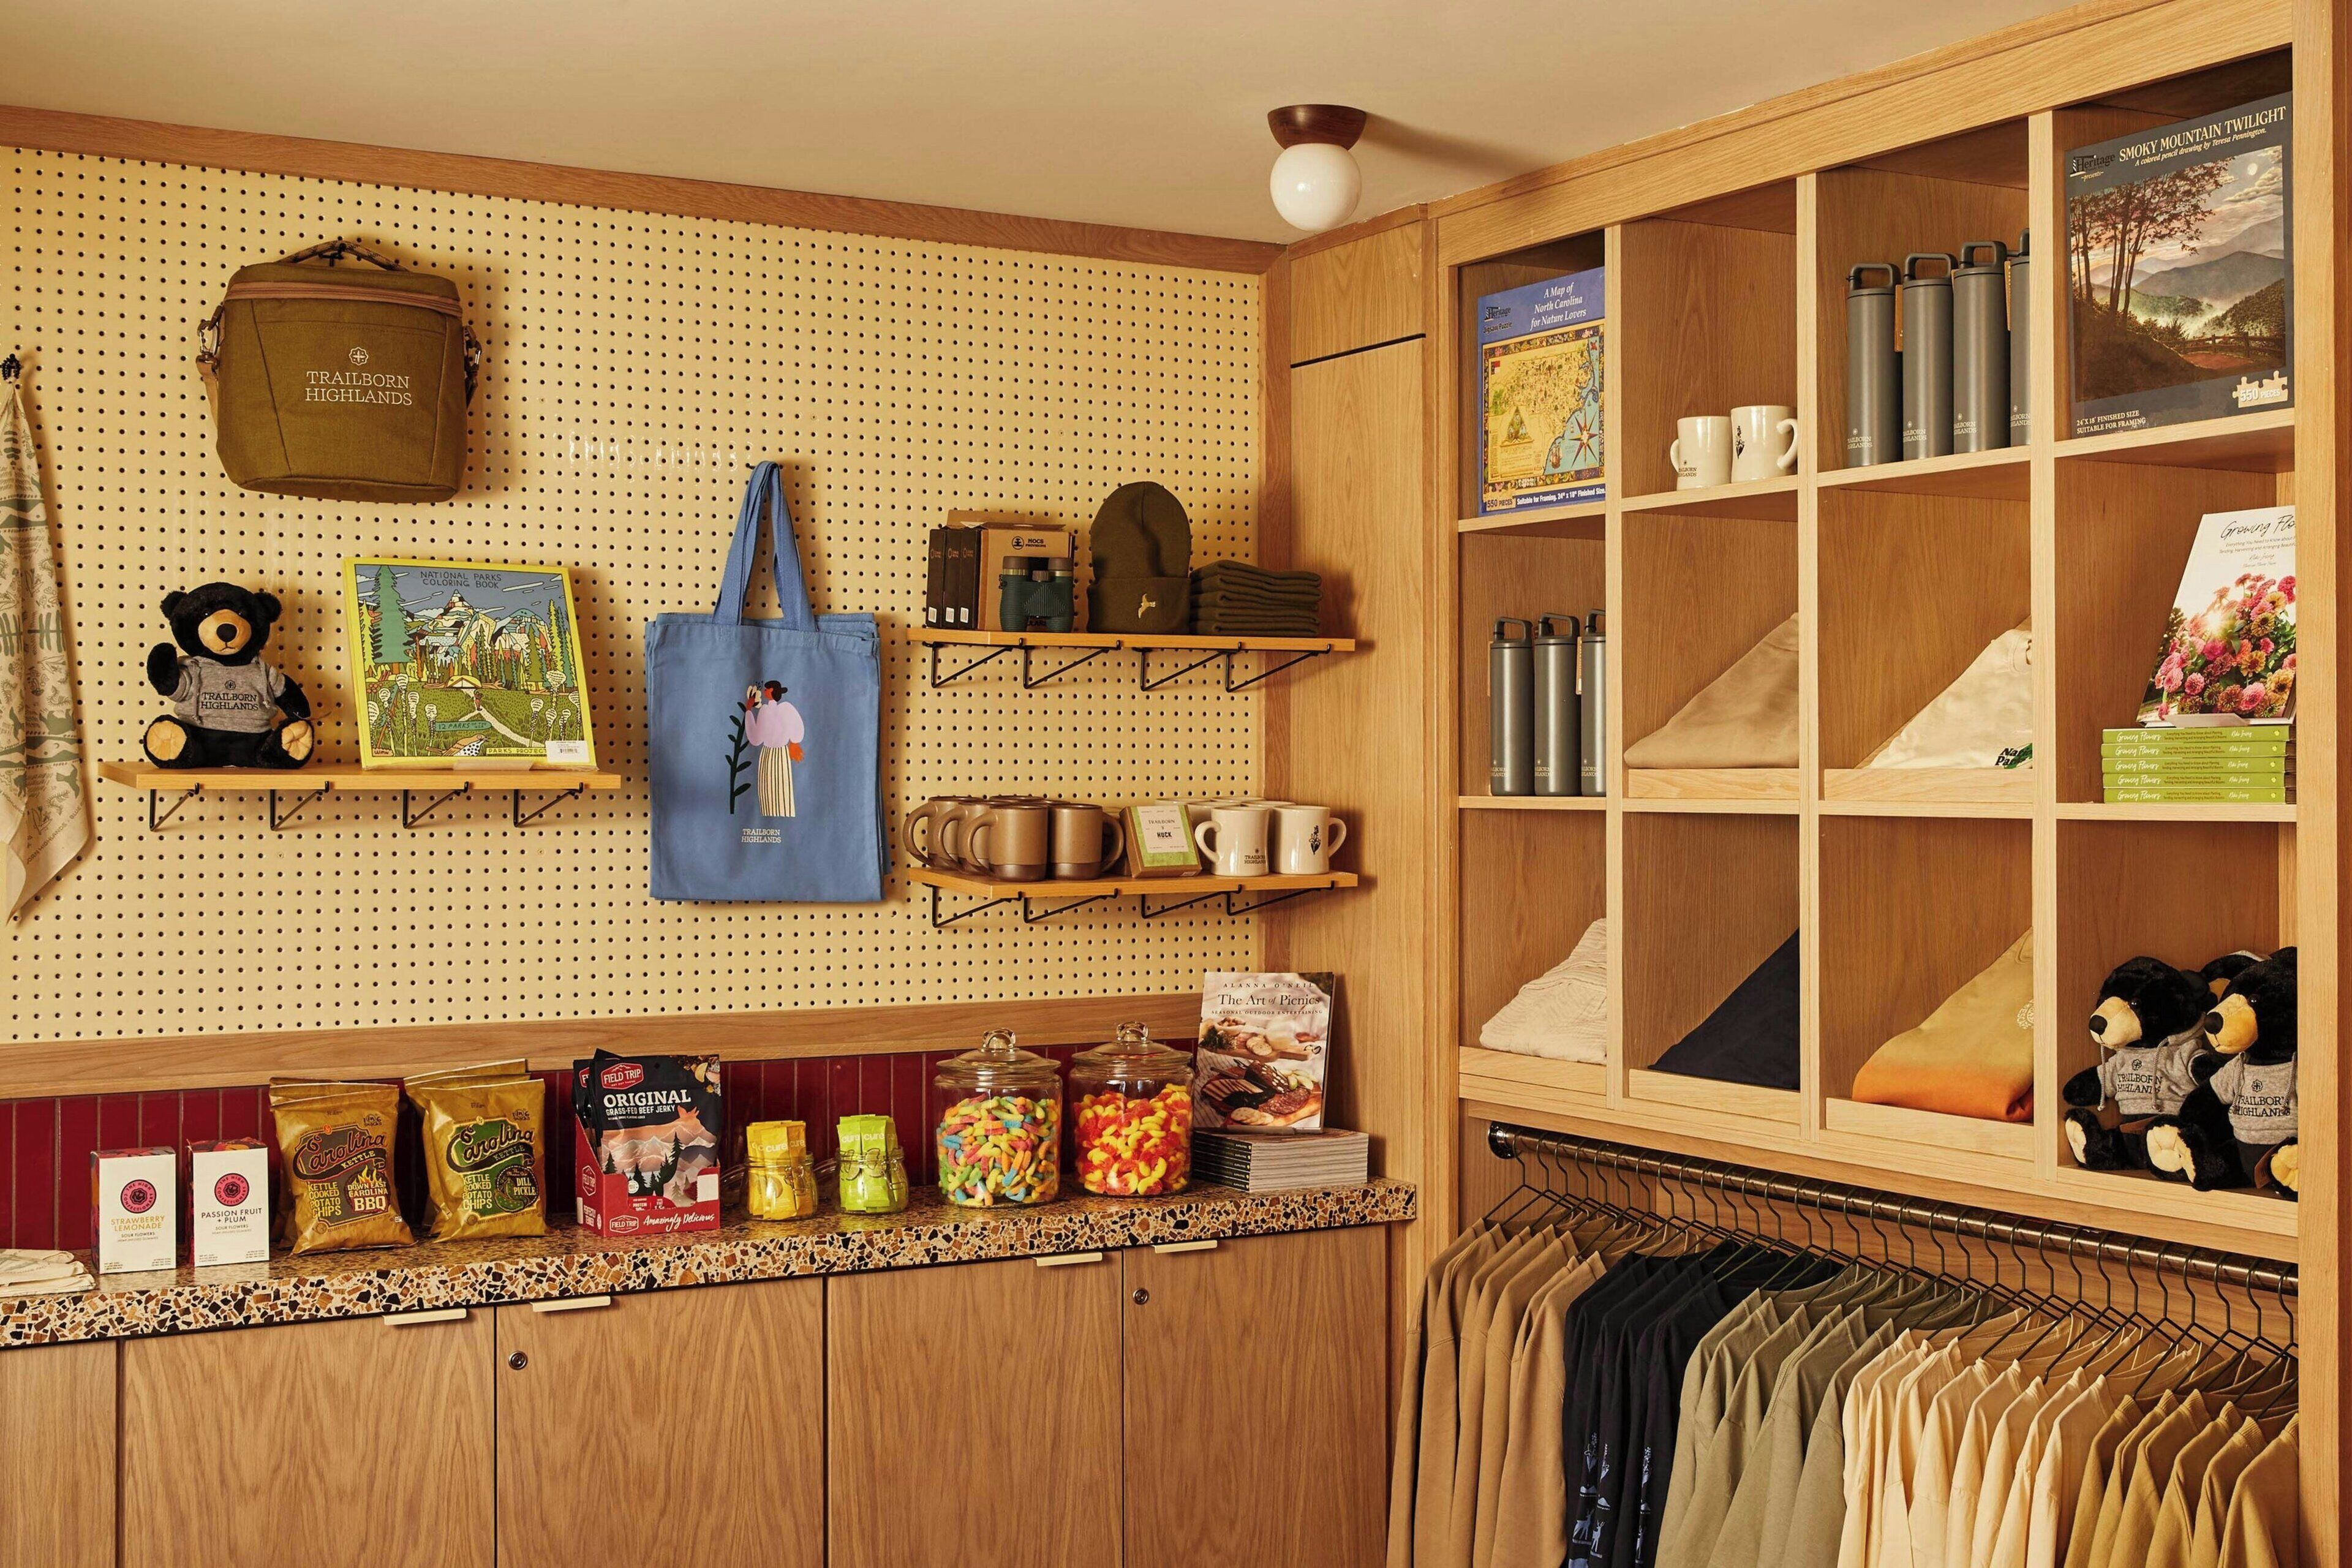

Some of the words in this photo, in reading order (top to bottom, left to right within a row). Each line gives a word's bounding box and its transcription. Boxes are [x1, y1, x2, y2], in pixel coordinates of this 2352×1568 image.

[2119, 140, 2158, 162] SMOKY
[2160, 123, 2222, 151] MOUNTAIN
[2225, 106, 2286, 134] TWILIGHT
[2141, 153, 2161, 165] colored
[2161, 149, 2178, 161] pencil
[2179, 144, 2203, 154] drawing
[2203, 141, 2211, 150] by
[2212, 138, 2231, 146] Teresa
[2232, 128, 2267, 141] Pennington.
[2074, 154, 2115, 172] Heritage
[1544, 289, 1550, 298] A
[1550, 286, 1565, 298] Map
[1566, 282, 1574, 295] of
[1534, 302, 1553, 314] North
[1555, 296, 1583, 309] Carolina
[1487, 307, 1511, 318] Heritage
[1530, 318, 1540, 331] for
[1542, 313, 1563, 325] Nature
[1565, 309, 1586, 320] Lovers
[306, 371, 410, 389] TRAILBORN
[305, 388, 412, 405] HIGHLANDS
[2240, 389, 2258, 402] 550
[2260, 388, 2280, 398] PIECES
[2097, 413, 2125, 423] FINISHED
[2126, 410, 2139, 418] SIZE
[2076, 424, 2105, 434] SUITABLE
[2117, 417, 2146, 428] FRAMING
[1578, 489, 1595, 497] Finished
[1487, 499, 1498, 508] 550
[2221, 521, 2271, 540] Growing
[202, 692, 257, 702] TRAILBORN
[201, 701, 258, 710] HIGHLANDS
[2117, 732, 2138, 742] Growing
[2140, 731, 2162, 741] Flowers
[2116, 746, 2137, 756] Growing
[2138, 745, 2160, 755] Flowers
[2116, 761, 2137, 772] Growing
[2138, 761, 2159, 770] Flowers
[2118, 775, 2139, 785] Growing
[2141, 774, 2161, 784] Flowers
[2117, 791, 2139, 801] Growing
[2140, 790, 2161, 800] Flowers
[1218, 994, 1242, 1005] The
[1246, 995, 1266, 1005] Art
[1280, 994, 1321, 1006] Picnics
[603, 1072, 624, 1084] FIELD
[625, 1069, 641, 1079] TRIP
[603, 1089, 691, 1108] ORIGINAL
[606, 1107, 638, 1116] GRASS-FED
[639, 1106, 654, 1114] BEEF
[655, 1104, 676, 1113] JERKY
[864, 1132, 885, 1140] cure
[447, 1123, 534, 1167] Carolina
[766, 1142, 788, 1153] cure
[294, 1131, 386, 1175] Carolina
[492, 1145, 525, 1161] KETTLE
[341, 1150, 375, 1169] KETTLE
[463, 1174, 490, 1185] KETTLE
[516, 1177, 531, 1186] DILL
[138, 1182, 151, 1191] HIGH
[308, 1182, 337, 1191] KETTLE
[464, 1182, 491, 1192] COOKED
[513, 1186, 537, 1196] PICKLE
[309, 1189, 340, 1200] COOKED
[349, 1188, 388, 1197] CAROLINA
[462, 1190, 492, 1199] POTATO
[310, 1197, 341, 1209] POTATO
[353, 1196, 386, 1212] BBQ
[463, 1199, 492, 1210] CHIPS
[202, 1210, 237, 1218] PASSION
[312, 1206, 342, 1218] CHIPS
[111, 1215, 165, 1226] STRAWBERRY
[644, 1213, 681, 1232] Amazingly
[683, 1212, 714, 1224] Delicious
[115, 1223, 162, 1232] LEMONADE
